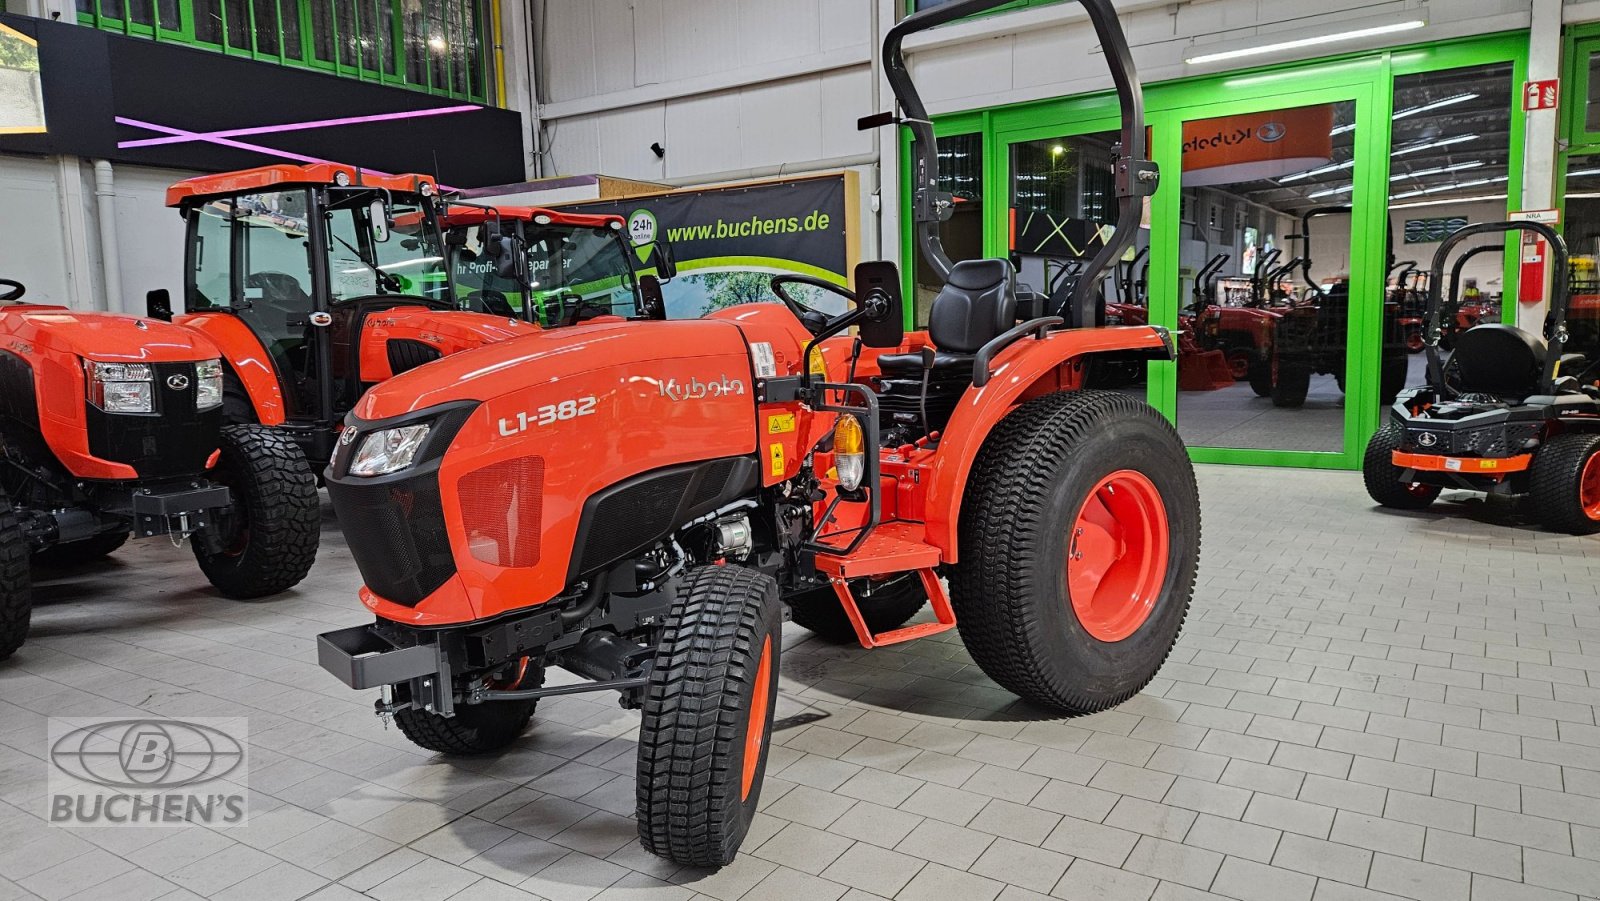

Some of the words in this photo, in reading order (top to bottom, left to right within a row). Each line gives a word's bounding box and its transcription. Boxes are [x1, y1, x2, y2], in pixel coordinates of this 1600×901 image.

[633, 219, 652, 231] 24h
[667, 210, 830, 242] www.buchens.de
[658, 375, 744, 401] Kubota
[499, 396, 597, 436] L1-382
